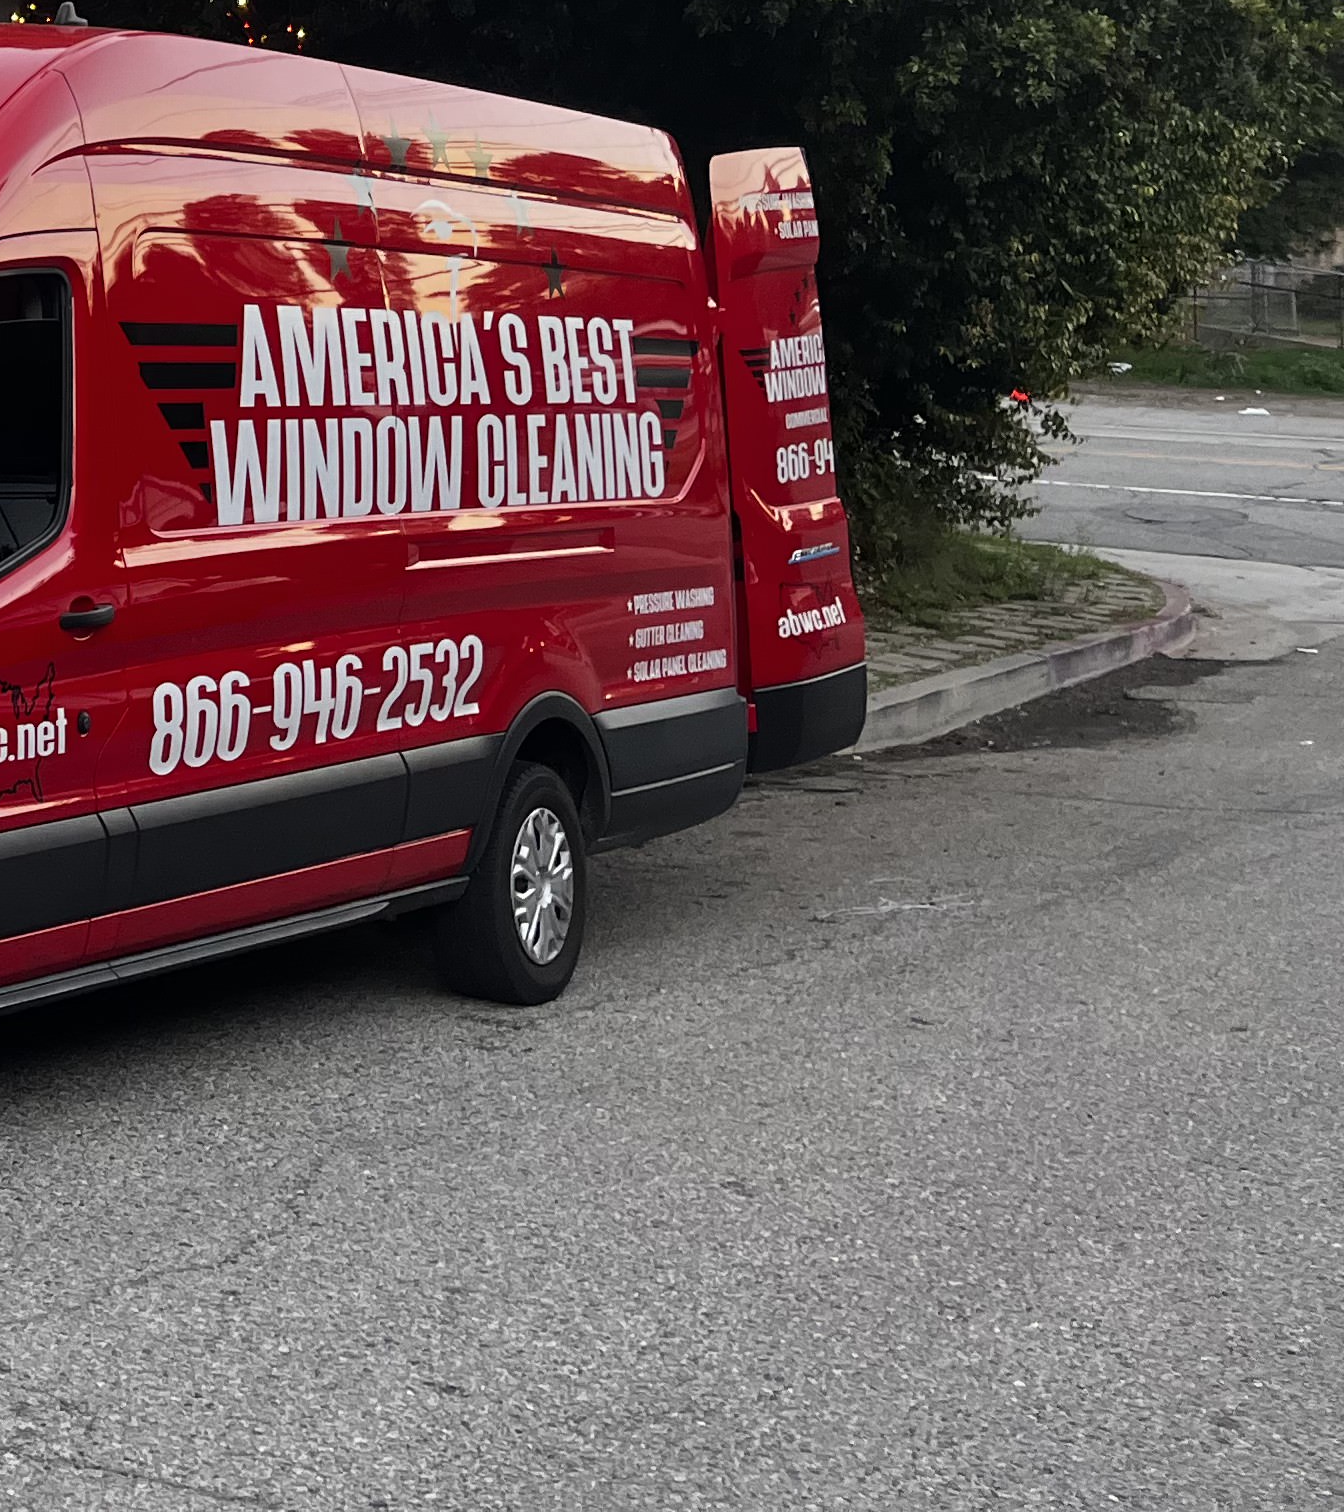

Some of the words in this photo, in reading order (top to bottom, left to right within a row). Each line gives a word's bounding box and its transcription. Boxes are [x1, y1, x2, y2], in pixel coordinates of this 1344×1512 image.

[778, 221, 802, 239] SOLAR
[240, 304, 532, 408] AMERICA'S
[538, 315, 637, 405] BEST
[770, 333, 825, 369] AMERIC
[764, 363, 826, 403] WINDOW
[210, 414, 463, 526] WINDOW
[477, 411, 666, 508] CLEANING
[633, 591, 674, 615] PRESSURE
[674, 586, 714, 609] WASHING
[778, 596, 847, 638] abwc.net
[635, 625, 665, 648] GUTTER
[666, 620, 704, 644] CLEANING
[633, 659, 661, 682] SOLAR
[661, 655, 688, 677] PANEL
[687, 648, 727, 673] CLEANING
[149, 634, 483, 776] 866-946-2532
